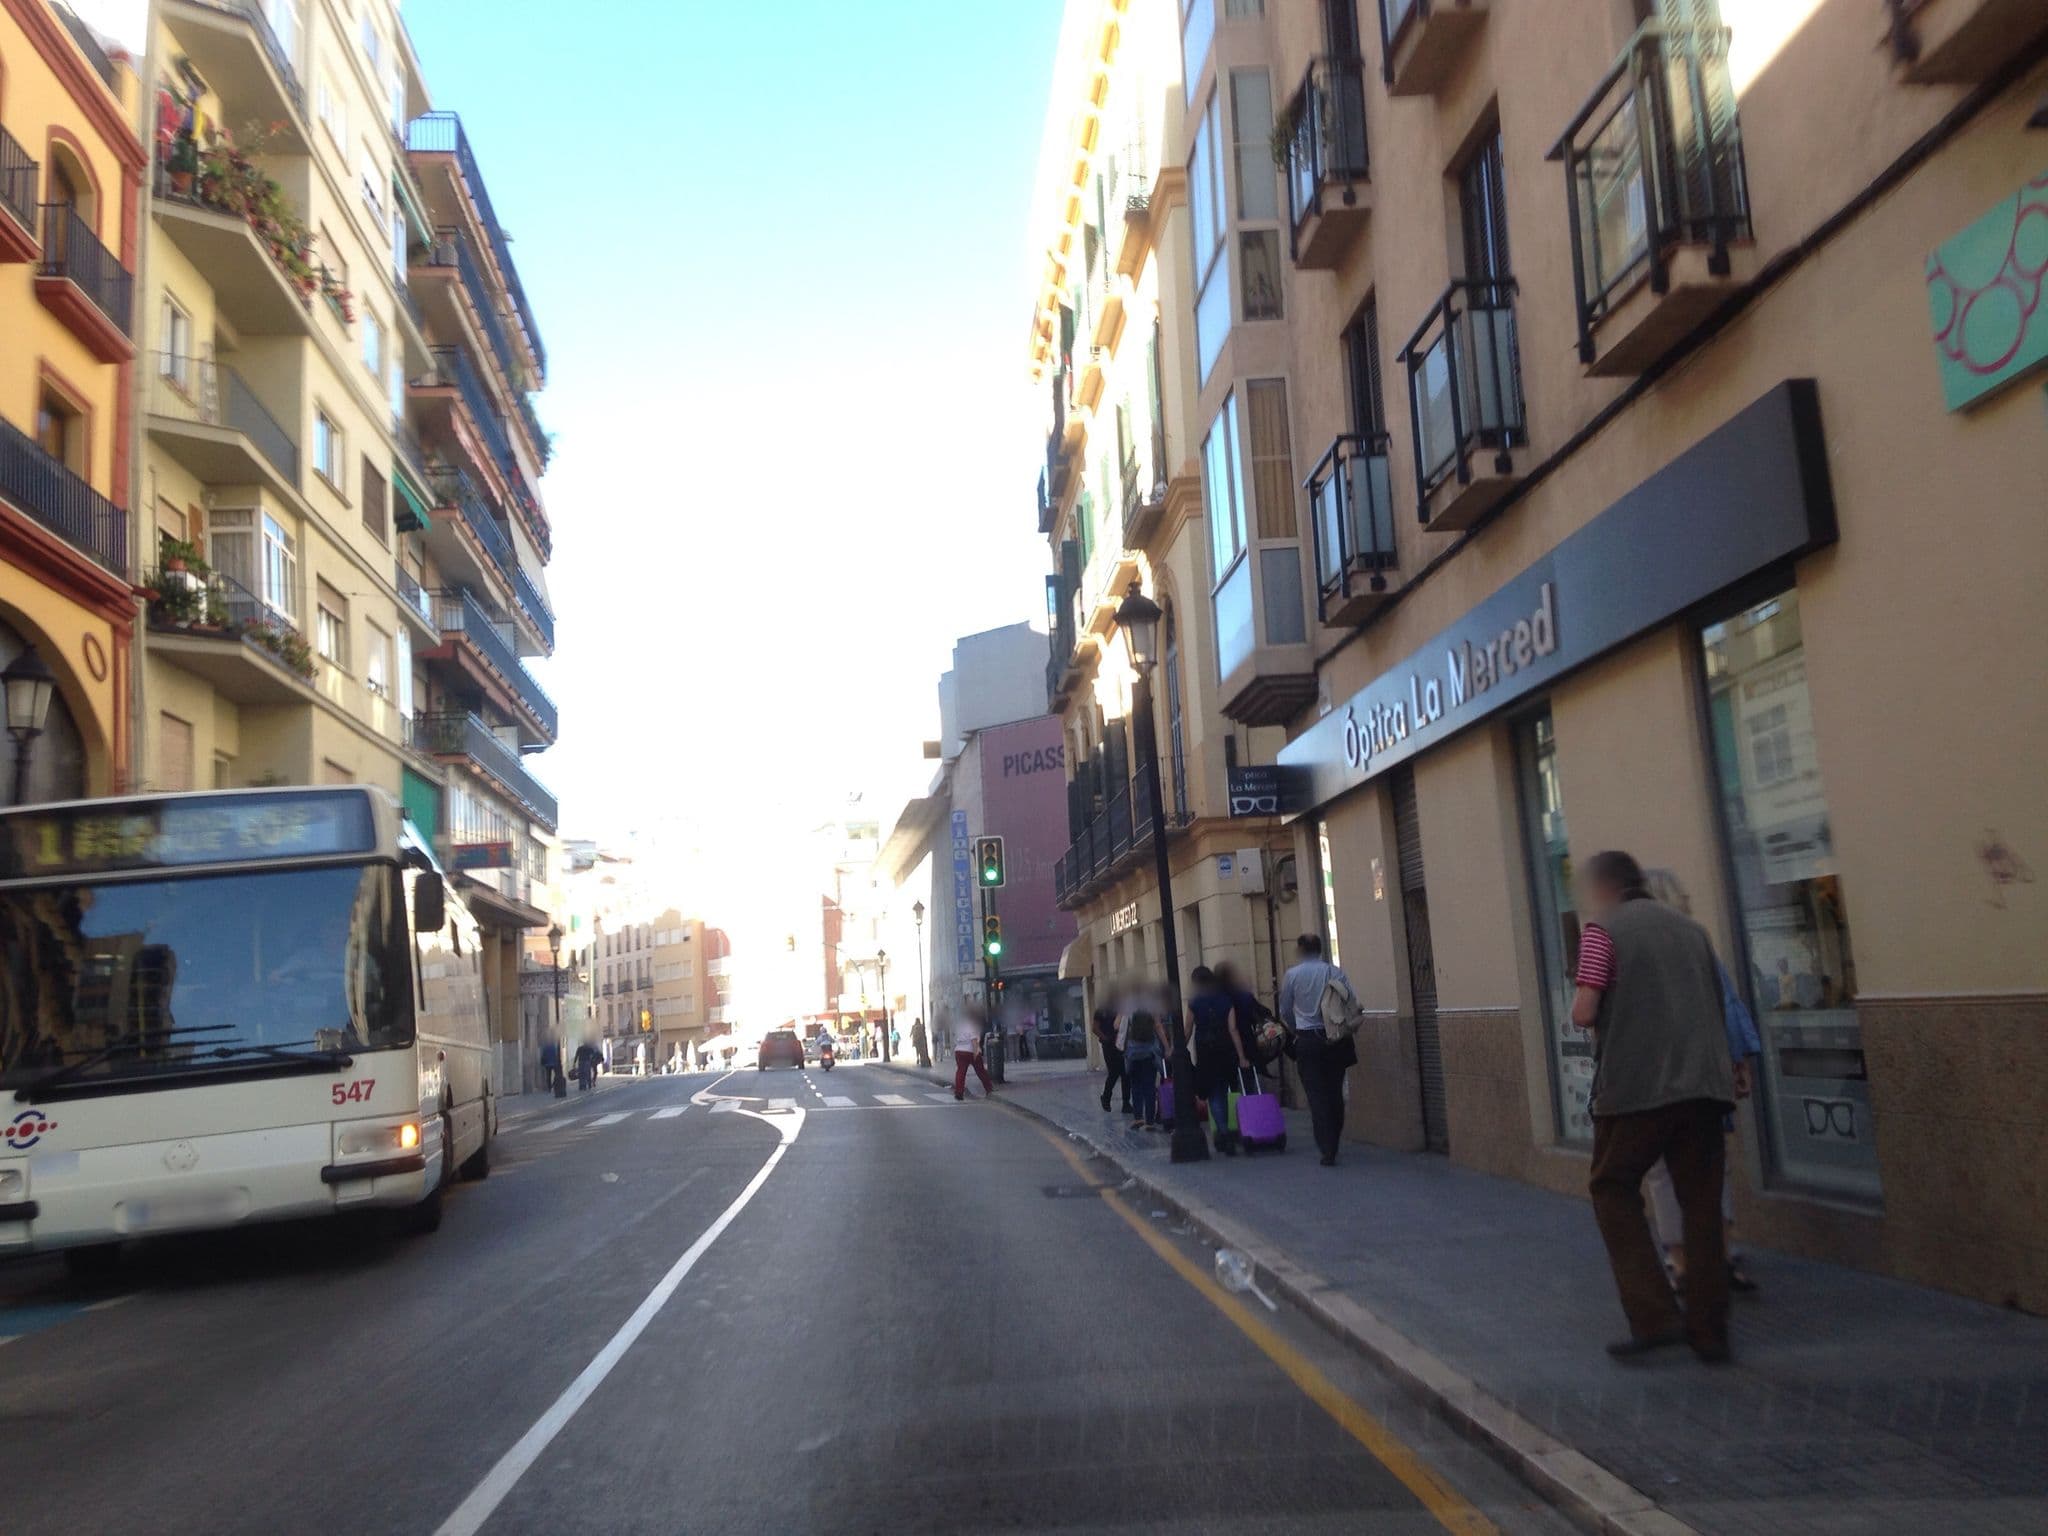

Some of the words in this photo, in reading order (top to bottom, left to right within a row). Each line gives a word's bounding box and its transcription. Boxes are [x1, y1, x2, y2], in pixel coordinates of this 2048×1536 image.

[1344, 698, 1408, 771] Óptica
[1409, 673, 1444, 729] La
[1447, 583, 1558, 708] Merced
[1230, 783, 1242, 793] La
[1244, 783, 1277, 793] Merced
[331, 1079, 376, 1105] 547
